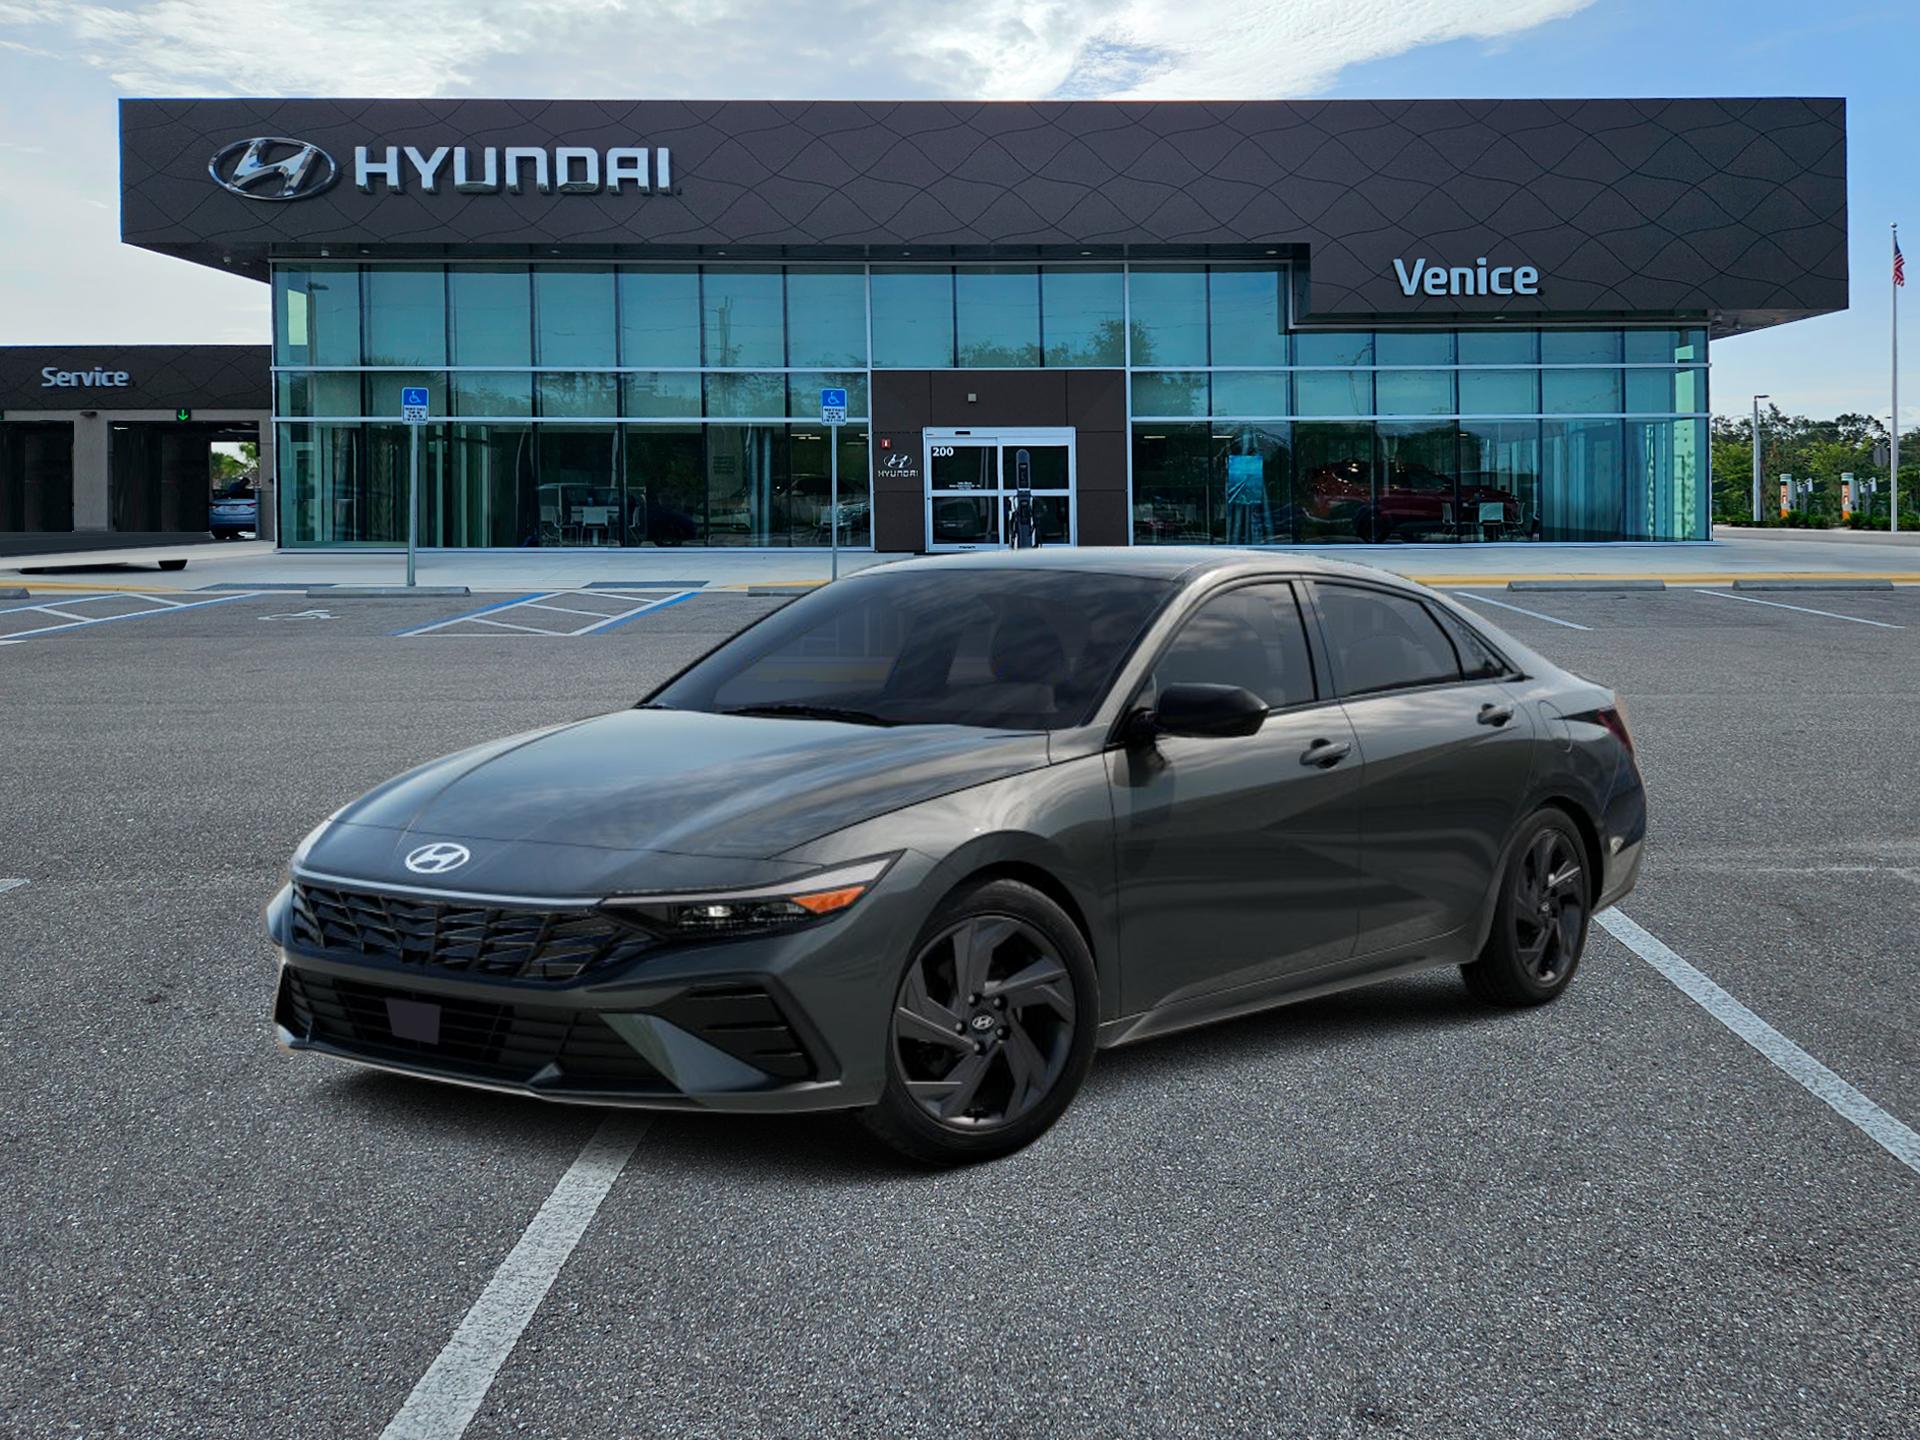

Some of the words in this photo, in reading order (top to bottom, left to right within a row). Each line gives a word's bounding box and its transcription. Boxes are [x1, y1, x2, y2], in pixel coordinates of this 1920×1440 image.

[354, 146, 672, 194] HYUNDAI
[1392, 256, 1540, 296] Venice
[41, 366, 130, 387] Service
[932, 446, 955, 457] 200
[878, 469, 919, 478] HYUNDAI
